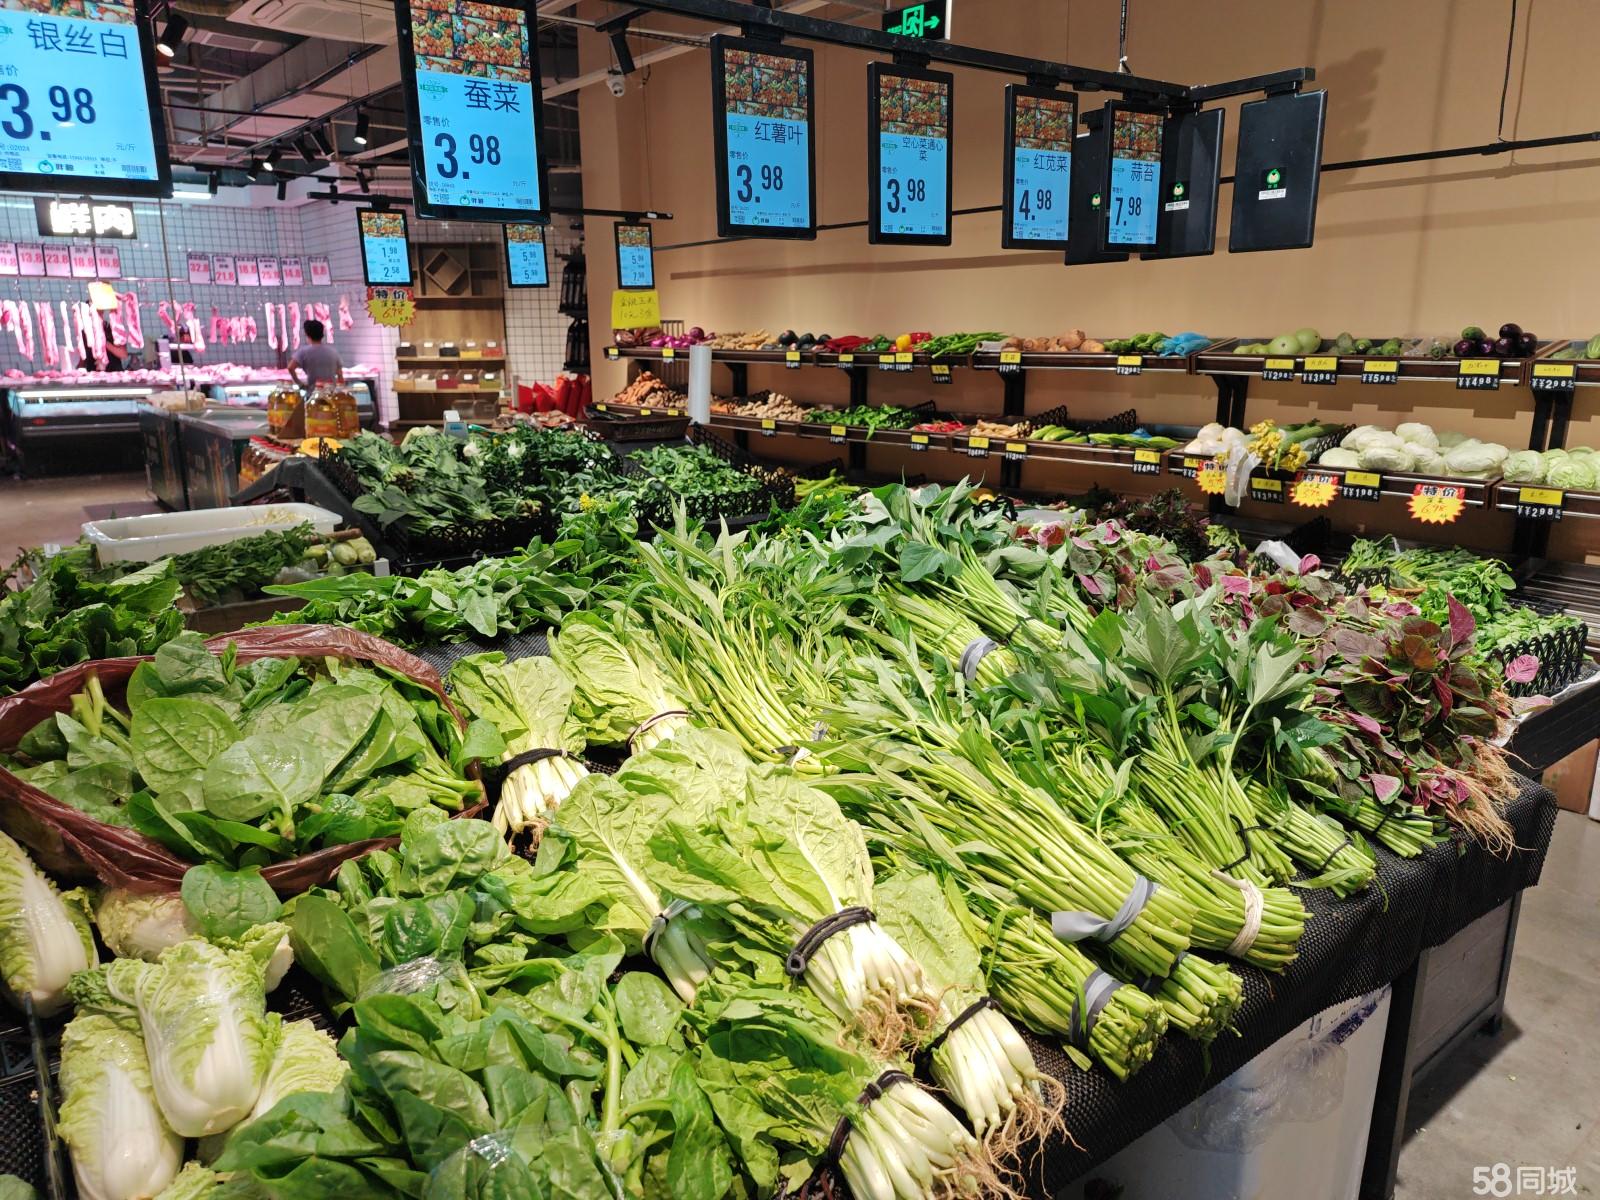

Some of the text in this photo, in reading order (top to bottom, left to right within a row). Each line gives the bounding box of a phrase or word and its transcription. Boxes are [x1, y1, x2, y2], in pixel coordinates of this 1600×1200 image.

[26, 19, 128, 59] 银丝白
[463, 79, 520, 113] 蚕菜
[0, 83, 96, 141] 3.98
[423, 115, 450, 128] 零售价
[754, 121, 804, 144] 红薯叶
[434, 132, 501, 179] 3.98
[1033, 153, 1068, 173] 红苋菜
[736, 164, 784, 203] 3.98
[1130, 161, 1155, 182] 蒜苔
[887, 178, 926, 214] 3.98
[1019, 189, 1053, 221] 4.98
[1115, 196, 1142, 227] 7.98
[50, 201, 134, 235] 鲜肉
[382, 247, 397, 258] 1.98
[375, 288, 405, 299] 特价
[1423, 485, 1456, 497] 特价
